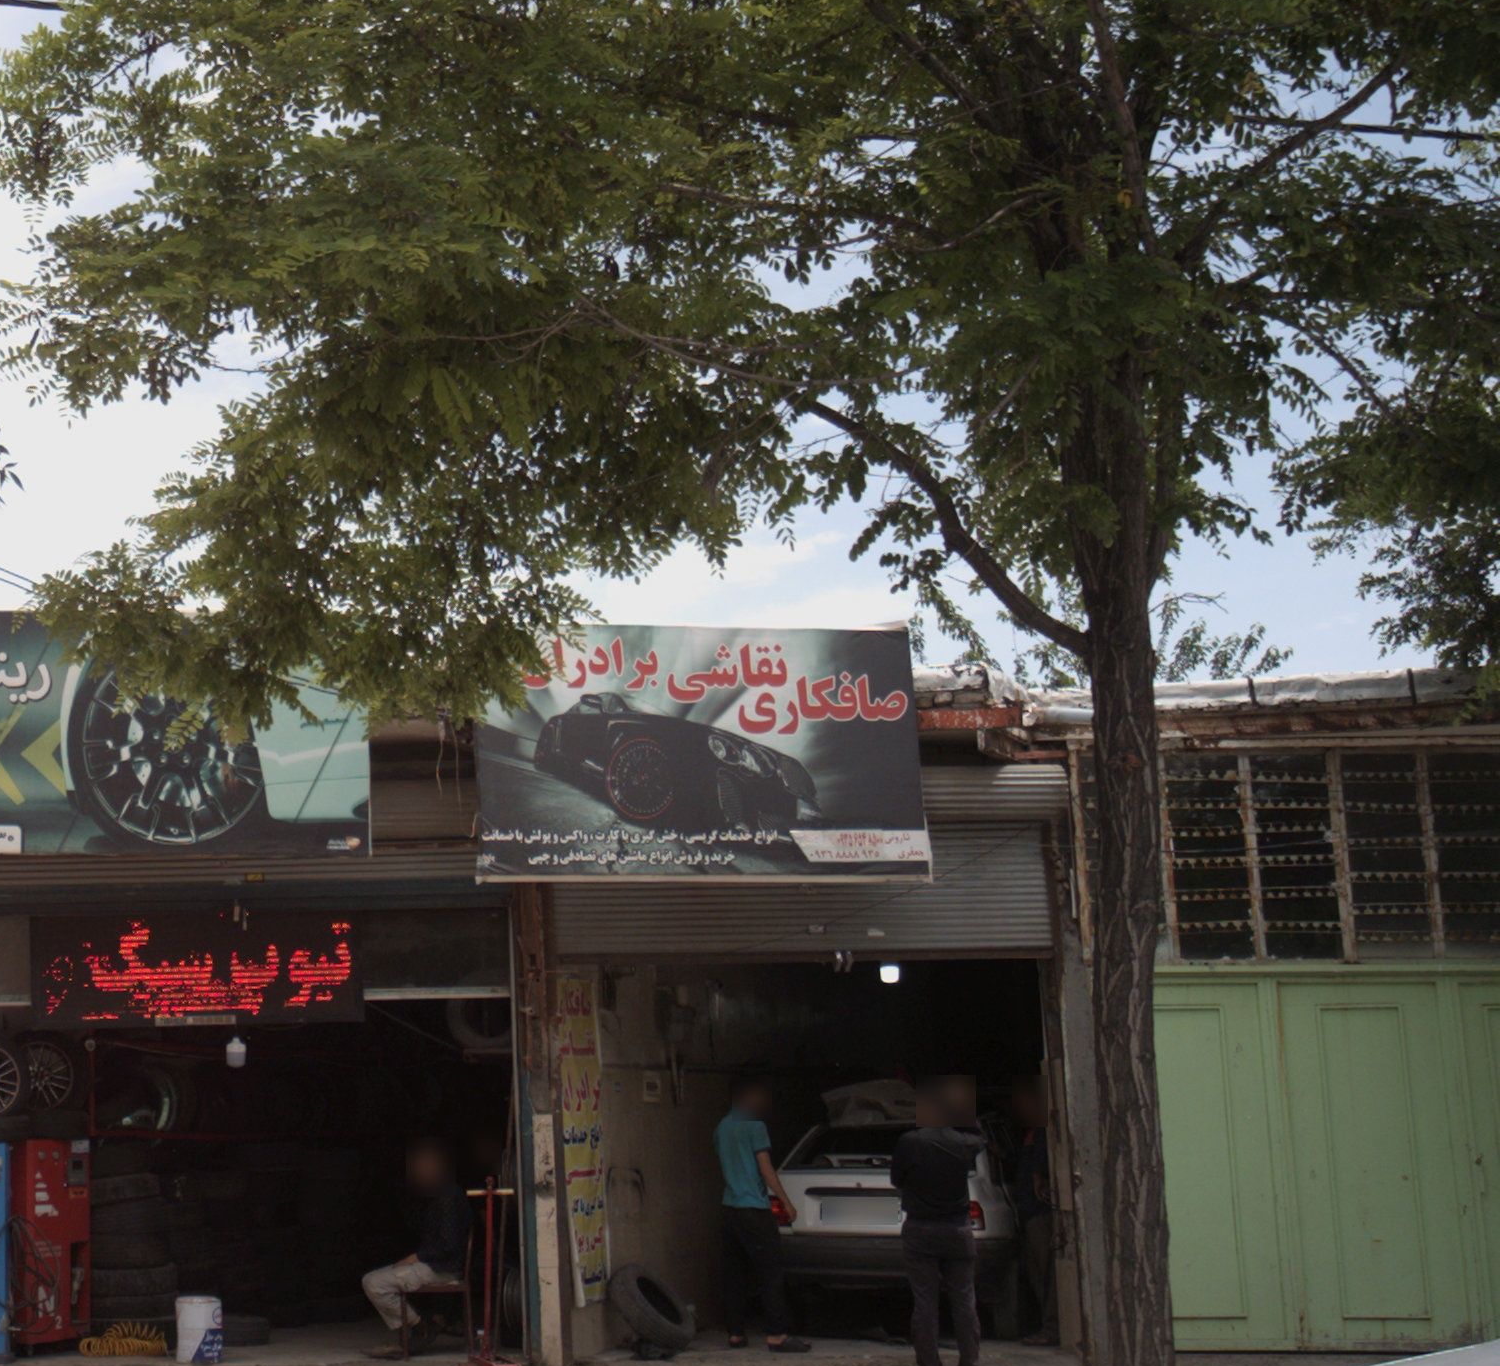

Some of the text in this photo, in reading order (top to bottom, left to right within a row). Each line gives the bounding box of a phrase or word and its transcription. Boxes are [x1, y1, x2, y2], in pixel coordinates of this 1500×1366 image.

[666, 642, 789, 704] نقاشی
[739, 672, 909, 735] صافکاری
[560, 848, 597, 865] تصادفی
[674, 850, 701, 865] فروش
[710, 849, 736, 865] خرید
